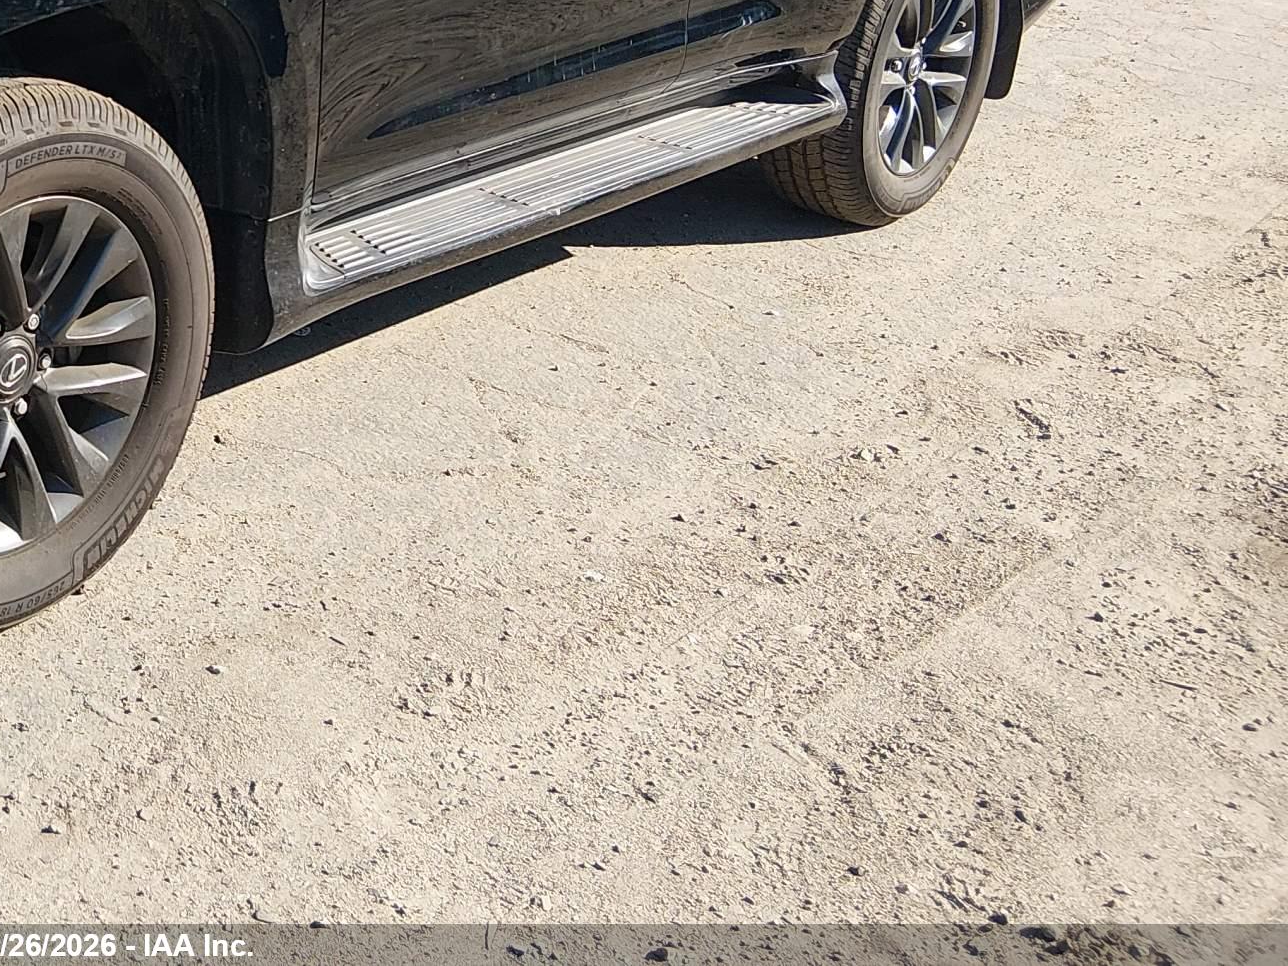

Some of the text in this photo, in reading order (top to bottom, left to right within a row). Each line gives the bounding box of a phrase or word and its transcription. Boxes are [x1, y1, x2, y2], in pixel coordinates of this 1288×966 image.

[14, 145, 73, 170] DEFENDER
[74, 144, 97, 156] LTX
[0, 606, 12, 618] 18
